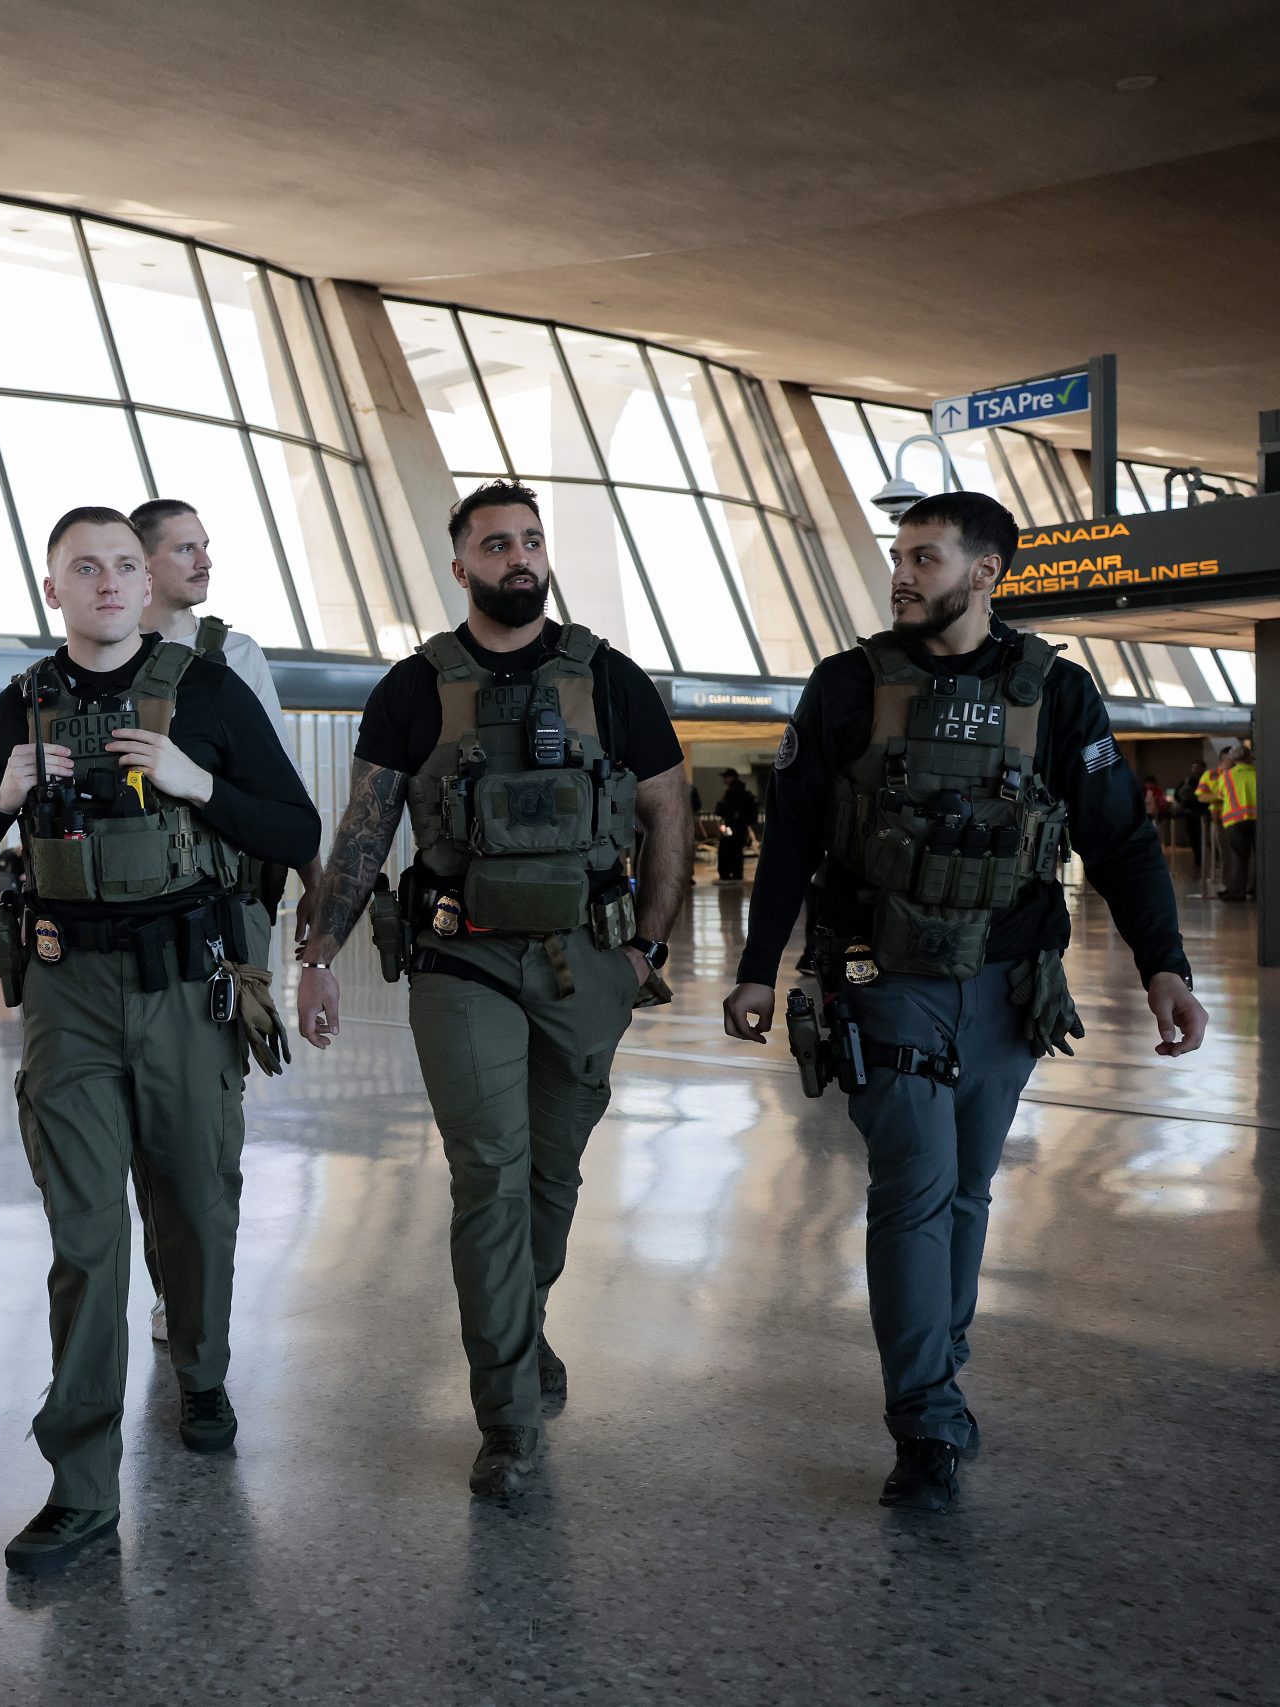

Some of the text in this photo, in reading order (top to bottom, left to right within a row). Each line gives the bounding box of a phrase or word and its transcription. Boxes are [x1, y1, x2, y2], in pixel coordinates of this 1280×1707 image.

[974, 392, 1054, 420] TSA Pre
[1017, 522, 1130, 549] CANADA
[991, 559, 1219, 598] URKISH AIRLINES
[1001, 554, 1123, 582] LANDAIR
[55, 713, 132, 740] POLICE
[933, 723, 979, 741] ICE
